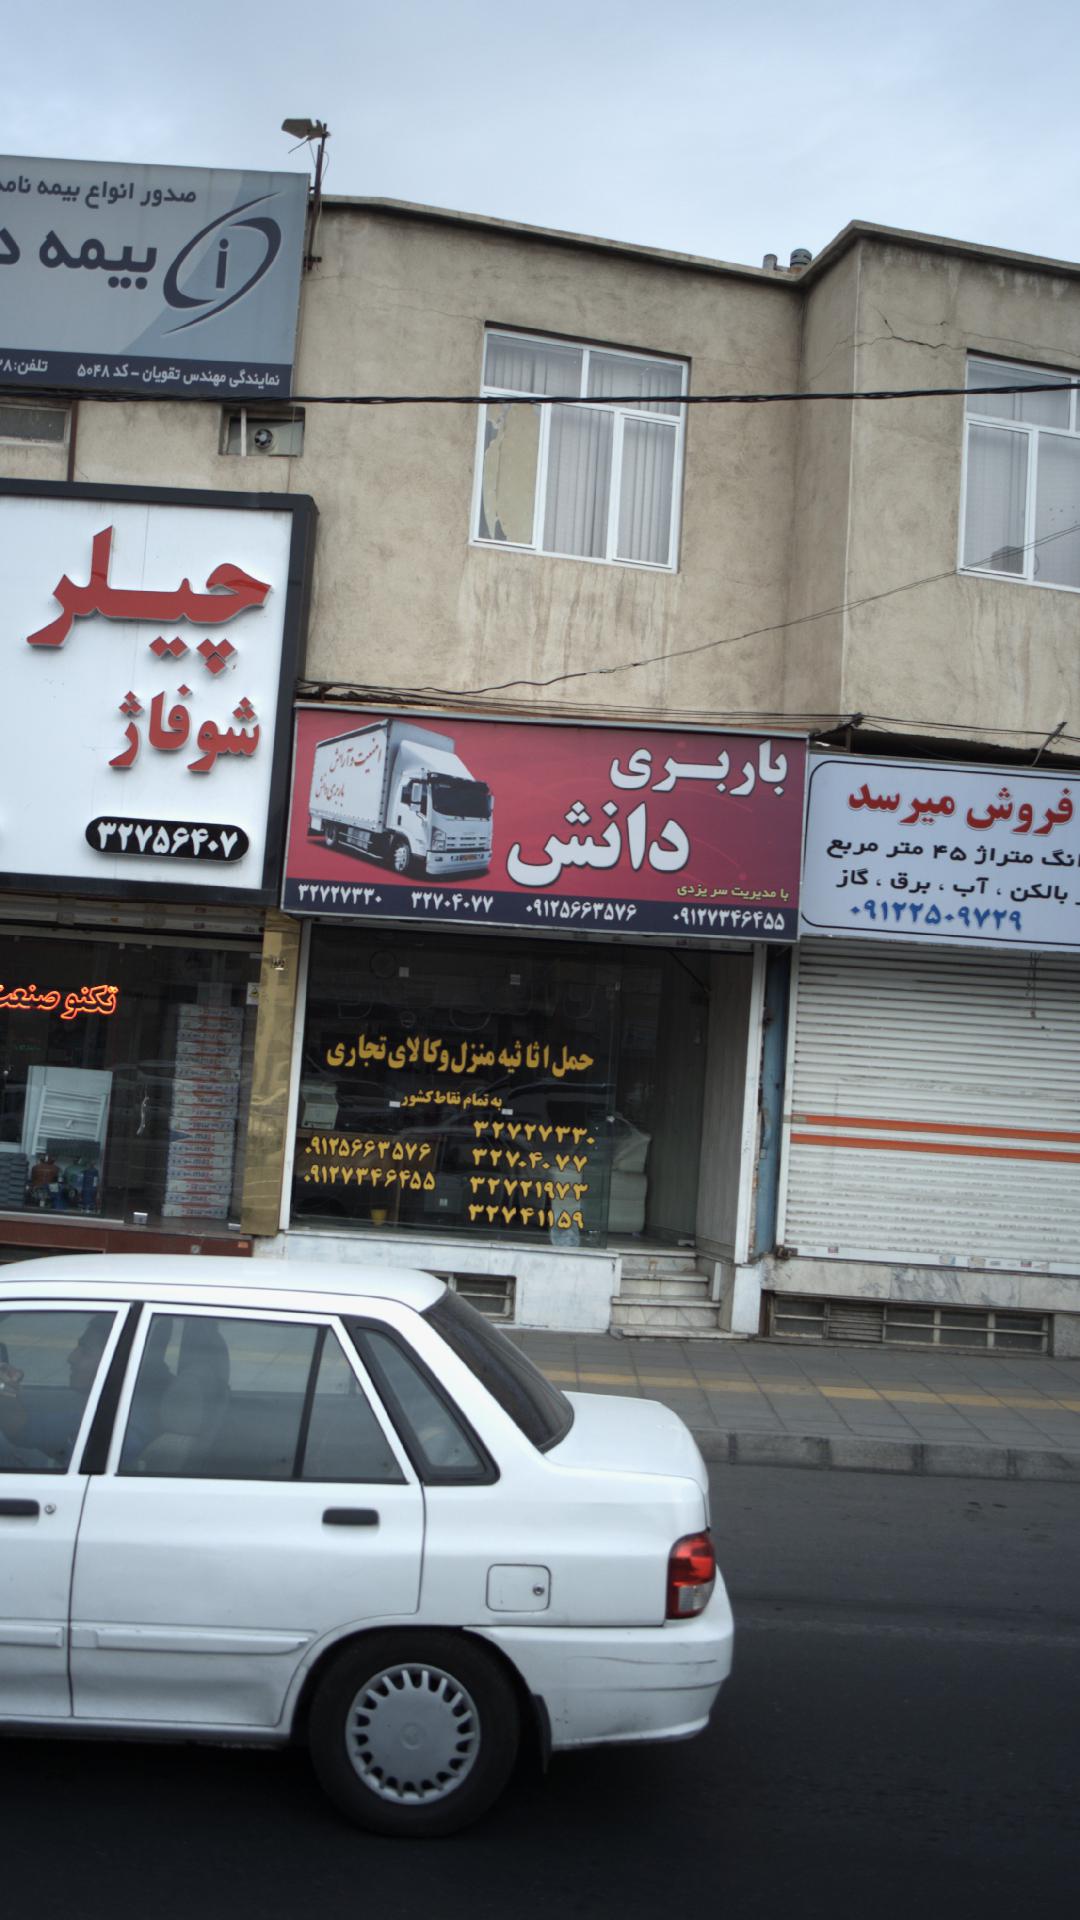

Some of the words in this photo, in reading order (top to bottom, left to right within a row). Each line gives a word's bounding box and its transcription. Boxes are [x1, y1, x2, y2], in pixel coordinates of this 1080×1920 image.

[0, 175, 32, 194] نام
[37, 180, 81, 202] بیمه
[84, 181, 135, 209] انواع
[139, 187, 197, 207] صدور
[39, 229, 158, 290] بیمه
[112, 363, 129, 377] کد
[142, 365, 181, 383] تقویان
[183, 370, 227, 387] مهندس
[229, 369, 280, 389] نمایندگی
[26, 525, 273, 676] چیلر
[108, 684, 261, 773] شوفاژ
[609, 739, 788, 796] باربری
[966, 787, 1074, 834] فروش
[98, 821, 239, 858] ۳۲۷۵۶۴۰۷
[506, 800, 690, 887] دانش
[826, 839, 879, 859] مربع
[886, 841, 924, 858] متر
[933, 845, 967, 861] ۴۵
[973, 845, 1033, 868] متراژ
[835, 868, 869, 888] گاز
[890, 872, 931, 894] برق
[952, 877, 989, 897] آب
[731, 887, 777, 900] مدیریت
[780, 888, 789, 901] با
[1010, 883, 1068, 904] بالکن
[298, 884, 382, 905] ۳۲۷۲۷۳۳۰
[411, 891, 494, 913] ۳۲۷۰۴۰۷۷
[526, 898, 637, 922] ۰۹۱۲۵۶۶۳۵۷۶
[673, 907, 785, 930] ۰۹۱۲۷۳۴۶۴۵۵
[850, 899, 1022, 931] ۰۹۱۲۲۵۰۹۷۲۹
[60, 984, 119, 1019] تکنو
[326, 1034, 387, 1068] تجاری
[451, 1040, 495, 1073] منزل
[552, 1042, 594, 1078] حمل
[401, 1089, 434, 1107] کشور
[434, 1090, 460, 1104] نقاط
[463, 1093, 489, 1110] تمام
[490, 1097, 503, 1111] به
[474, 1120, 595, 1145] ۳۲۷۲۷۳۳۰
[305, 1136, 431, 1161] ۰۹۱۲۵۶۶۳۵۷۶
[472, 1148, 587, 1173] ۳۲۷۰۴۰۷۷
[304, 1164, 435, 1190] ۰۹۱۲۷۳۴۶۴۵۵
[470, 1176, 588, 1201] ۳۲۷۲۱۹۷۳
[468, 1203, 584, 1229] ۳۲۷۴۱۱۵۹
